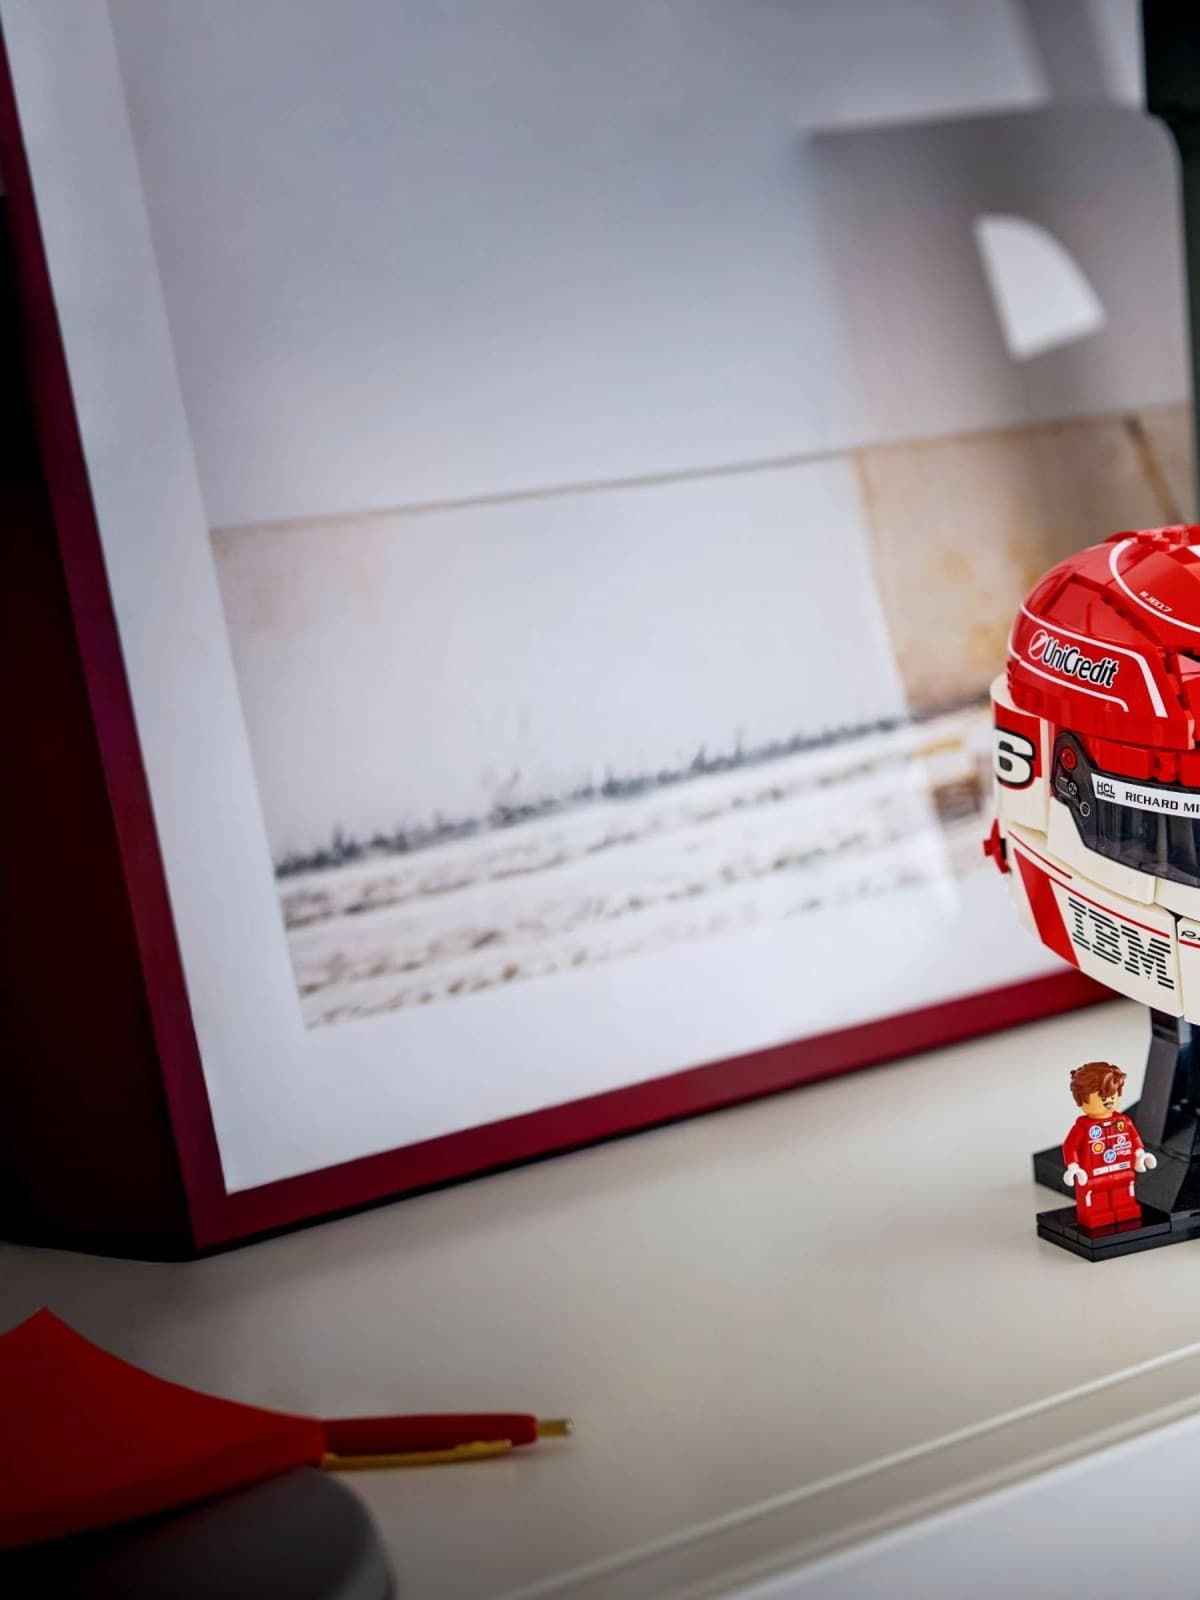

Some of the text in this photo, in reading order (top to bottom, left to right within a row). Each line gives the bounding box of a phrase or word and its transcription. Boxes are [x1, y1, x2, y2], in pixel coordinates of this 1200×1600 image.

[1042, 637, 1118, 687] UniCredit
[994, 726, 1035, 787] 6
[1097, 781, 1116, 795] HCL
[1125, 791, 1179, 810] RICHARD
[1068, 897, 1175, 990] IBM
